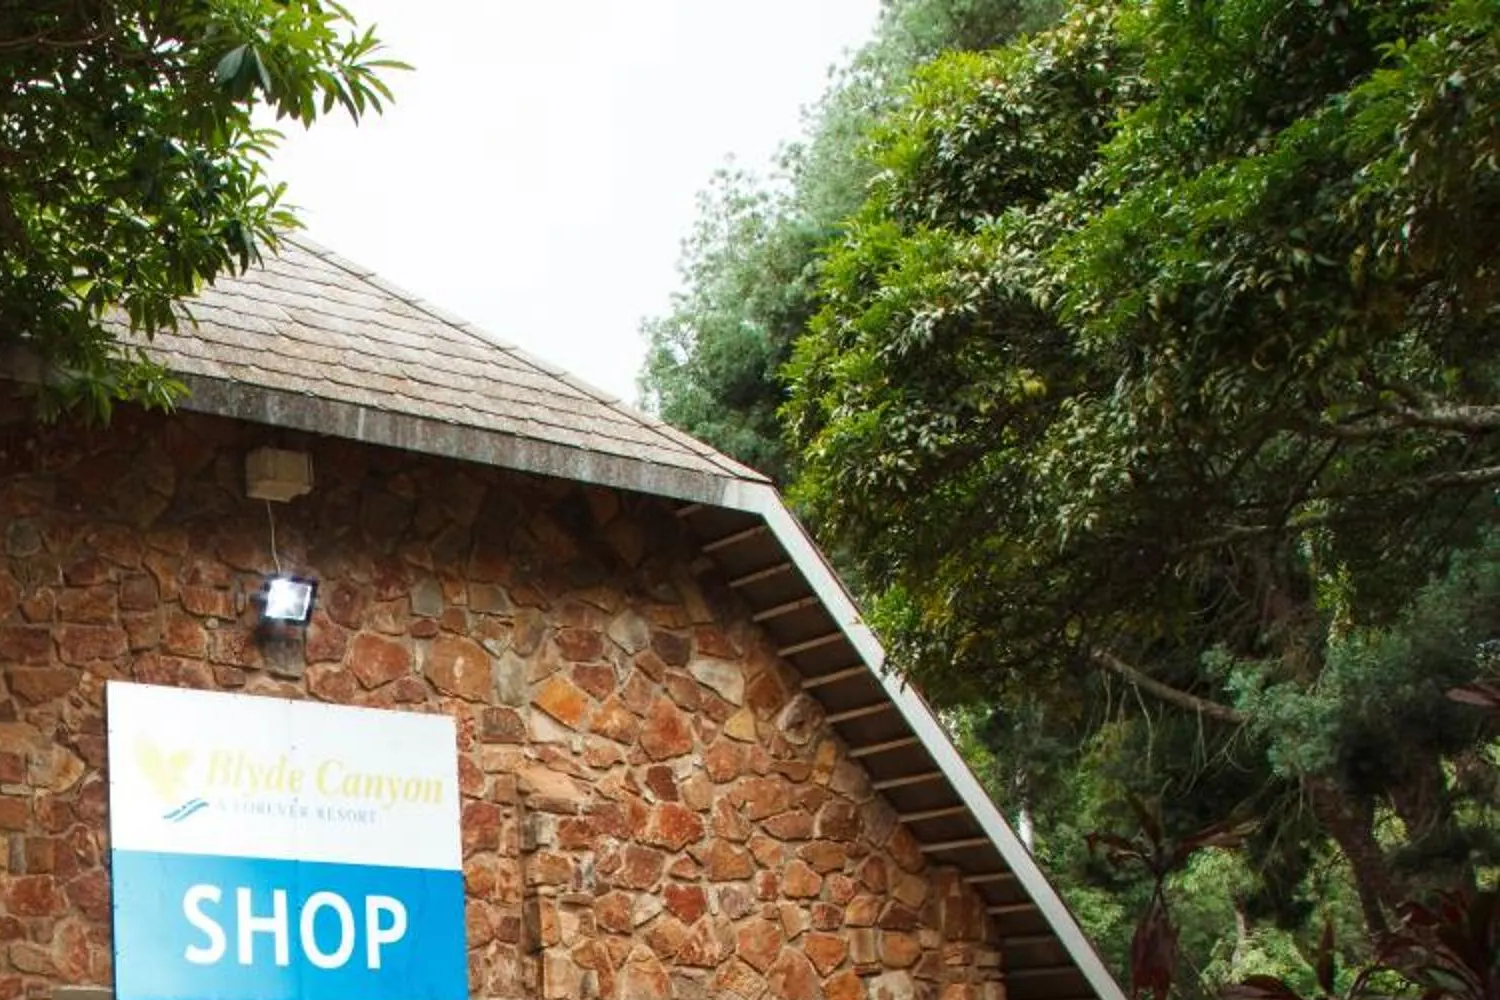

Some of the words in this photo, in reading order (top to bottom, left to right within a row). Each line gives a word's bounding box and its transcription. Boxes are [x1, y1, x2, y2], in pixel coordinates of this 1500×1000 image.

[206, 748, 305, 797] Blyde
[315, 759, 444, 809] Canyon
[316, 807, 378, 824] RESORT
[182, 883, 408, 970] SHOP
